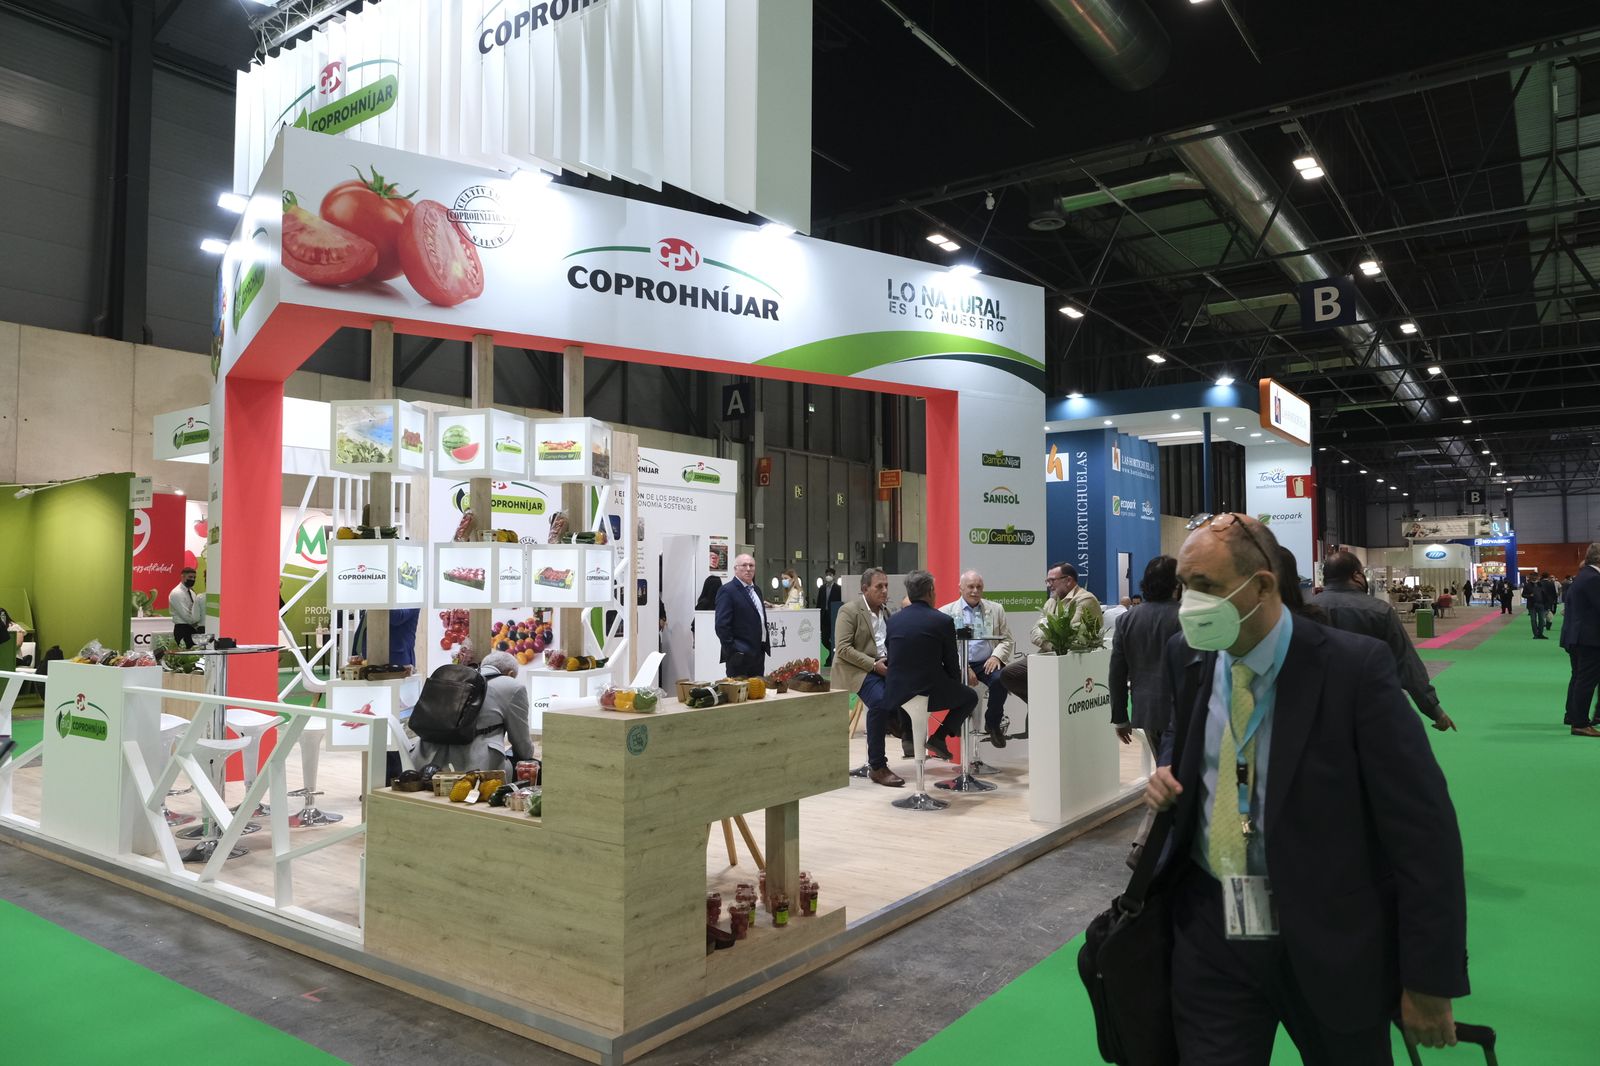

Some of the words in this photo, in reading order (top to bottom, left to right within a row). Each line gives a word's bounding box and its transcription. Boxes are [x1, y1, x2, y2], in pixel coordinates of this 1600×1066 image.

[311, 85, 393, 134] COPROHNÍJAR
[567, 265, 780, 321] COPROHNÍJAR
[888, 278, 916, 303] LO
[921, 285, 1007, 321] NATURAL
[1314, 286, 1341, 322] B
[889, 301, 907, 315] ES
[915, 305, 933, 320] LO
[941, 310, 1005, 333] NUESTRO
[727, 390, 745, 416] A
[490, 499, 543, 512] OPROHNÍJAR
[663, 502, 697, 512] SOSTENIBLE
[668, 497, 694, 505] PREMIOS
[1076, 450, 1089, 550] HORTICHUELAS
[1471, 491, 1480, 502] B
[1272, 512, 1302, 521] ecopark
[970, 530, 988, 542] BIO
[1077, 553, 1089, 577] LAS
[338, 573, 387, 581] COPROHNÍJAR
[305, 616, 316, 625] DE
[1068, 693, 1110, 715] COPROHNÍJAR
